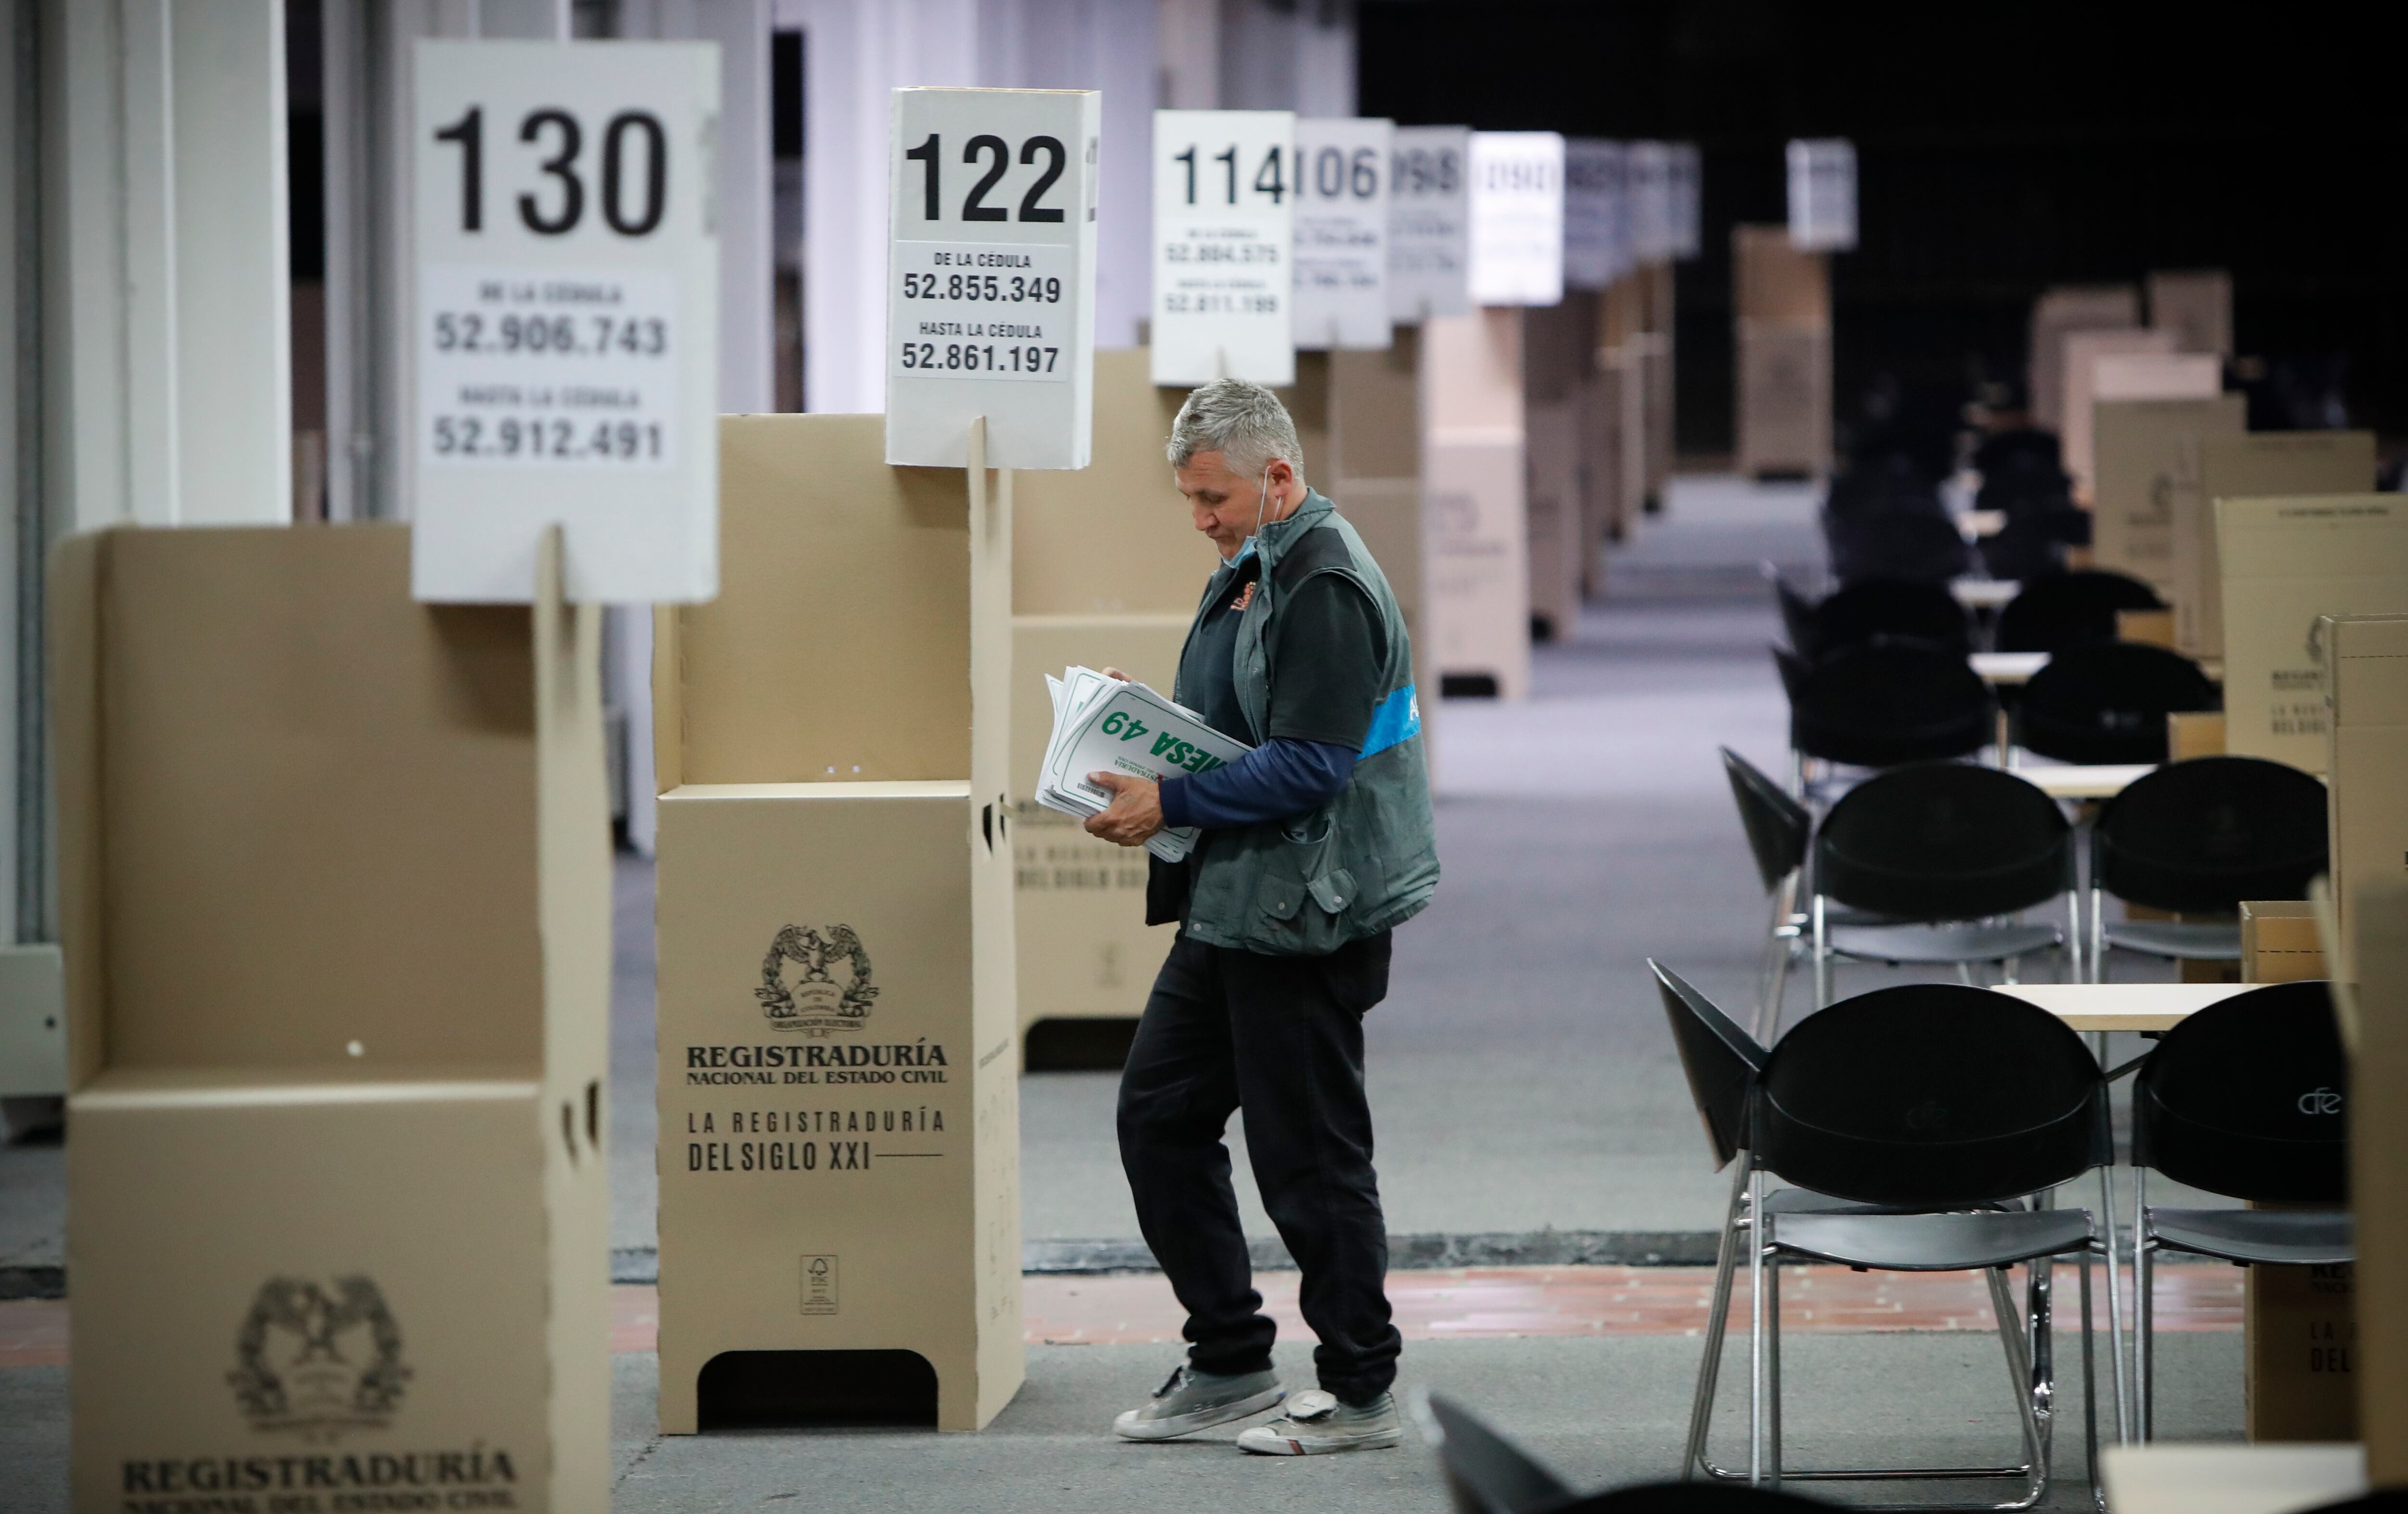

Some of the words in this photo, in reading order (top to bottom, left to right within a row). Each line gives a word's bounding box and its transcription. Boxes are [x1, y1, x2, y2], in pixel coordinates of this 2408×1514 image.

[433, 105, 669, 239] 130
[906, 133, 1067, 224] 122
[1174, 145, 1287, 206] 114
[934, 252, 952, 266] DE
[957, 253, 973, 266] LA
[978, 251, 1032, 268] CÉDULA
[904, 273, 1061, 303] 52.855.349
[434, 312, 667, 356] 52.906.743
[919, 322, 963, 336] HASTA
[968, 323, 984, 336] LA
[989, 321, 1043, 339] CÉDULA
[902, 342, 1060, 373] 52.861.197
[433, 415, 662, 461] 52.912.491
[1101, 711, 1150, 741] 49
[687, 1037, 948, 1068] REGISTRADURÍA
[687, 1071, 776, 1085] NACIONAL
[784, 1071, 819, 1085] DEL
[825, 1071, 896, 1084] ESTADO
[901, 1070, 948, 1084] CIVIL
[688, 1112, 716, 1134] LA
[732, 1106, 944, 1133] REGISTRADURÍA
[829, 1142, 870, 1171] XXI
[120, 1440, 518, 1494] REGISTRADURÍA
